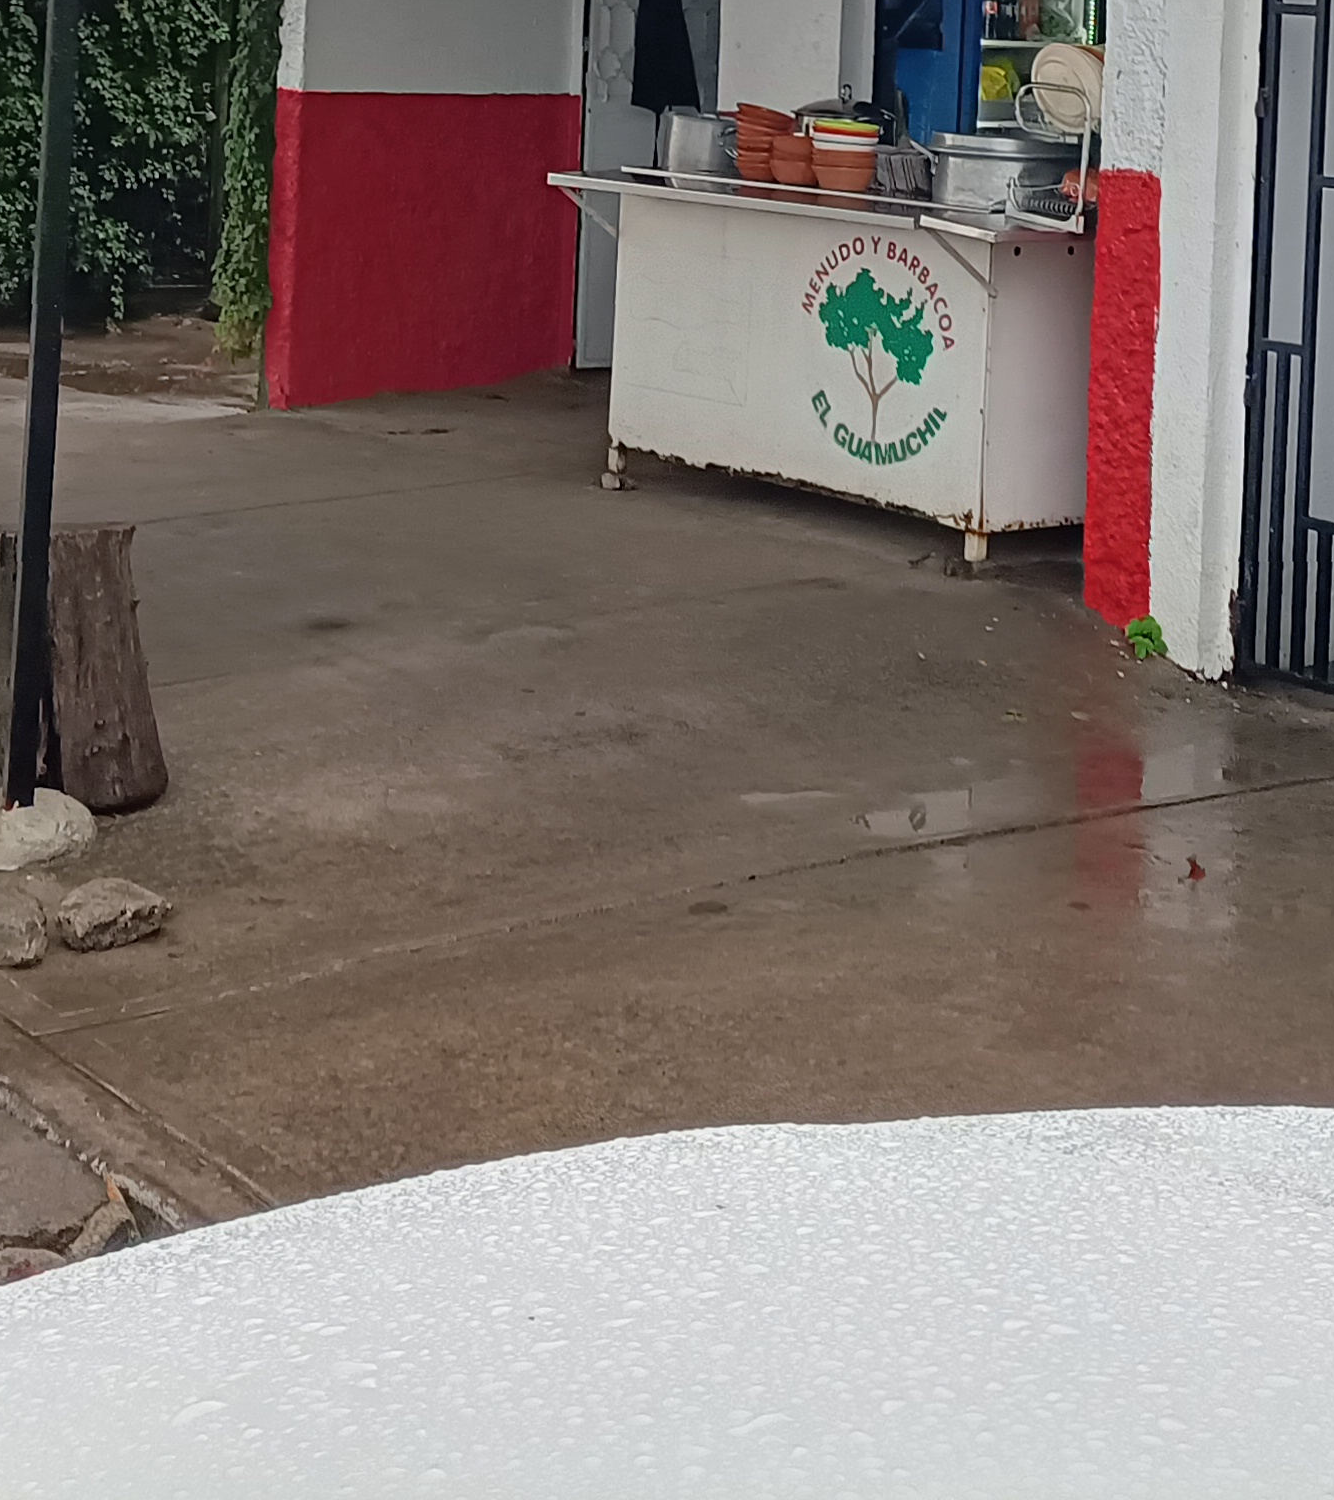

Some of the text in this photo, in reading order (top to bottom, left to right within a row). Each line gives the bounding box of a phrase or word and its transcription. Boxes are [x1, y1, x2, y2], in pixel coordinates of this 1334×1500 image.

[801, 235, 955, 351] MENUDO Y BARBACOA
[811, 389, 948, 466] EL GUAMUCHIL
